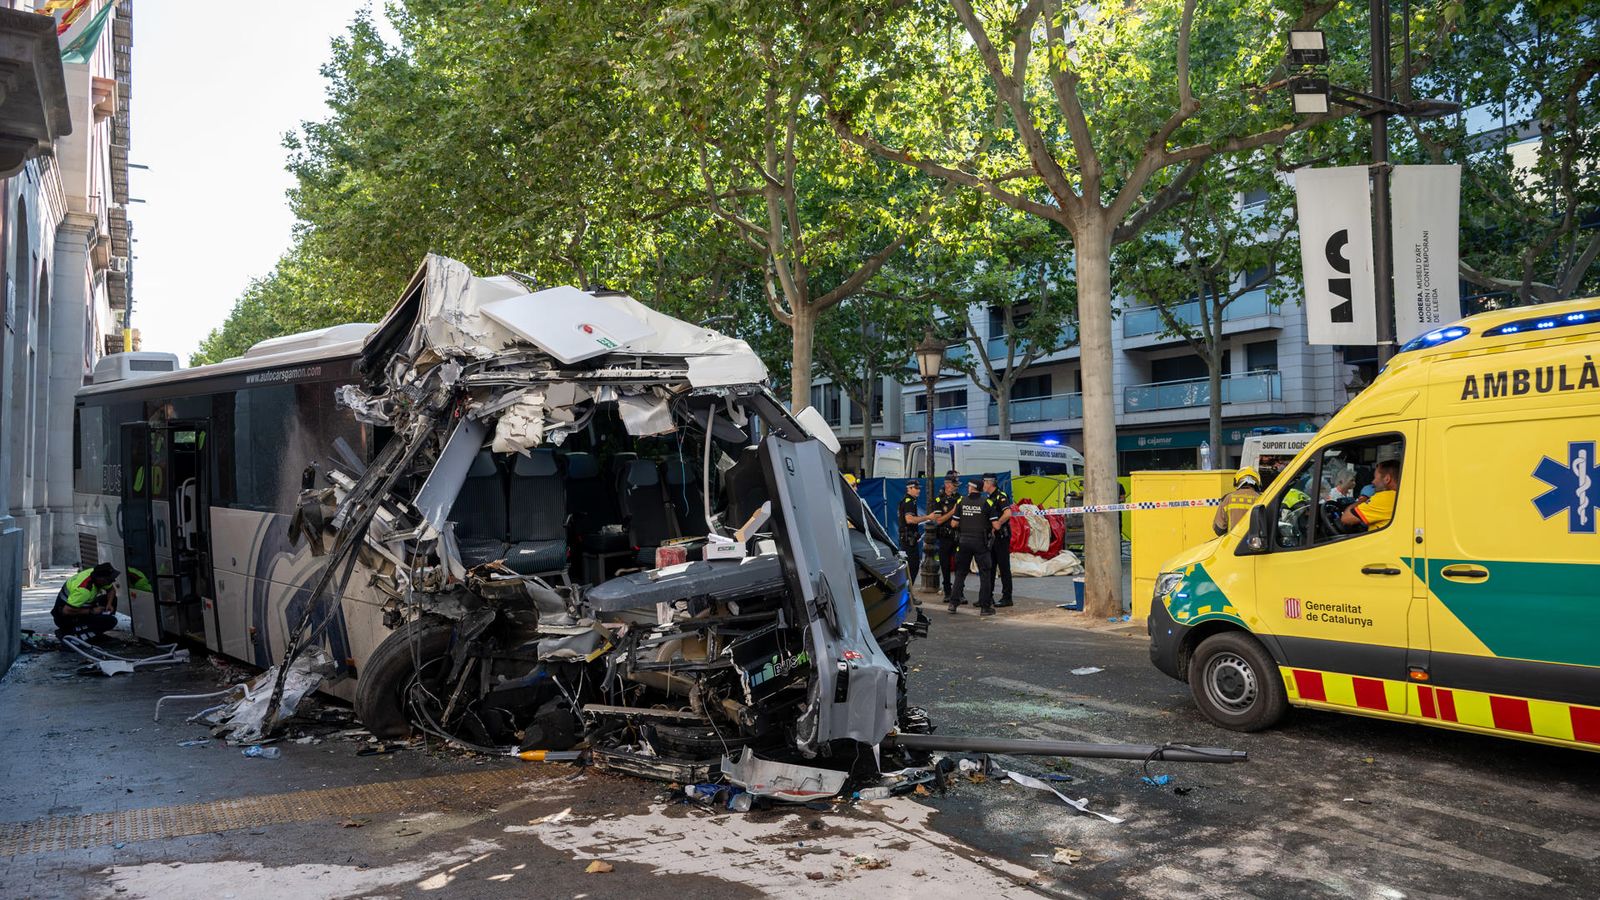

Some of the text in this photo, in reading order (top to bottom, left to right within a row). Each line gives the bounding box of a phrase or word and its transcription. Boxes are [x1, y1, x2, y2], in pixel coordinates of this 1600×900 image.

[1433, 313, 1440, 323] DE
[246, 366, 321, 384] www.autocarsgamon.com
[1460, 355, 1600, 400] AMBULÀ
[1147, 436, 1172, 446] cajamar
[1262, 440, 1309, 450] SUPORT LOGÍS
[1305, 600, 1362, 614] Generalitat
[1306, 613, 1373, 628] de Catalunya
